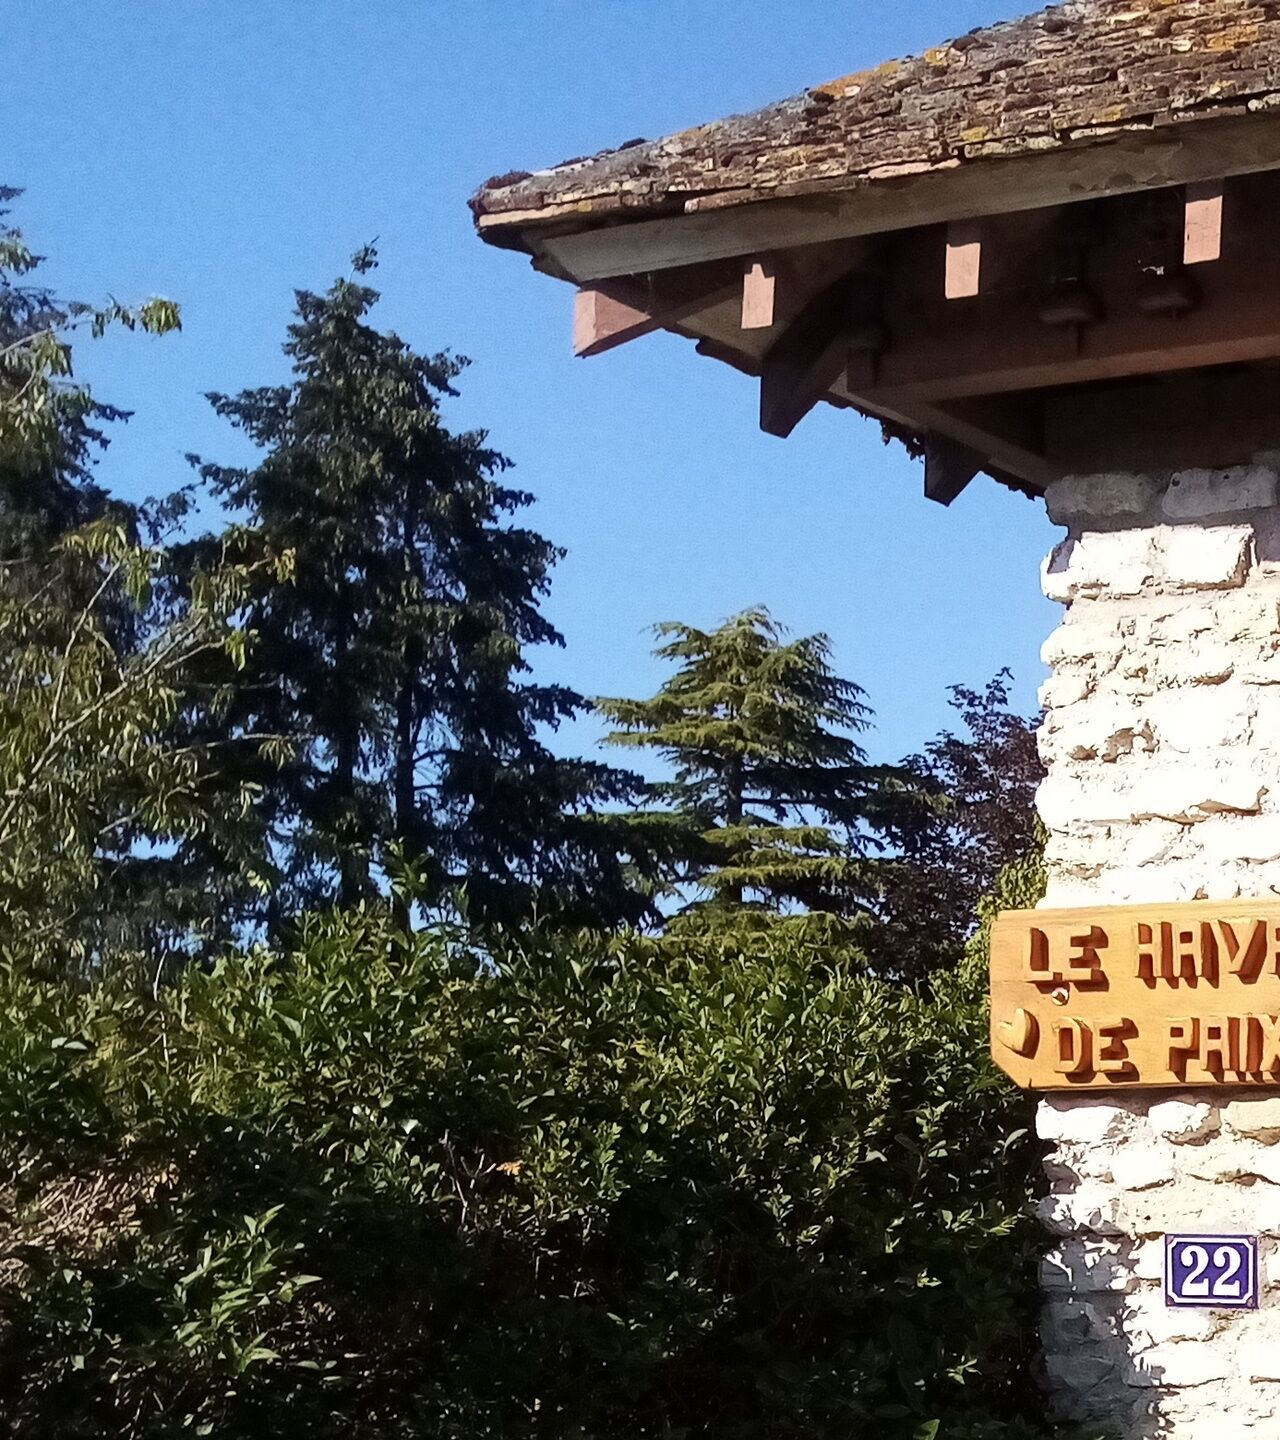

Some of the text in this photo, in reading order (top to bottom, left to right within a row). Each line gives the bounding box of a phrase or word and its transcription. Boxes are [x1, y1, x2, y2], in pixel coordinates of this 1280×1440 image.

[1028, 925, 1108, 989] LE
[1051, 1017, 1138, 1081] DE
[1180, 1245, 1241, 1296] 22
